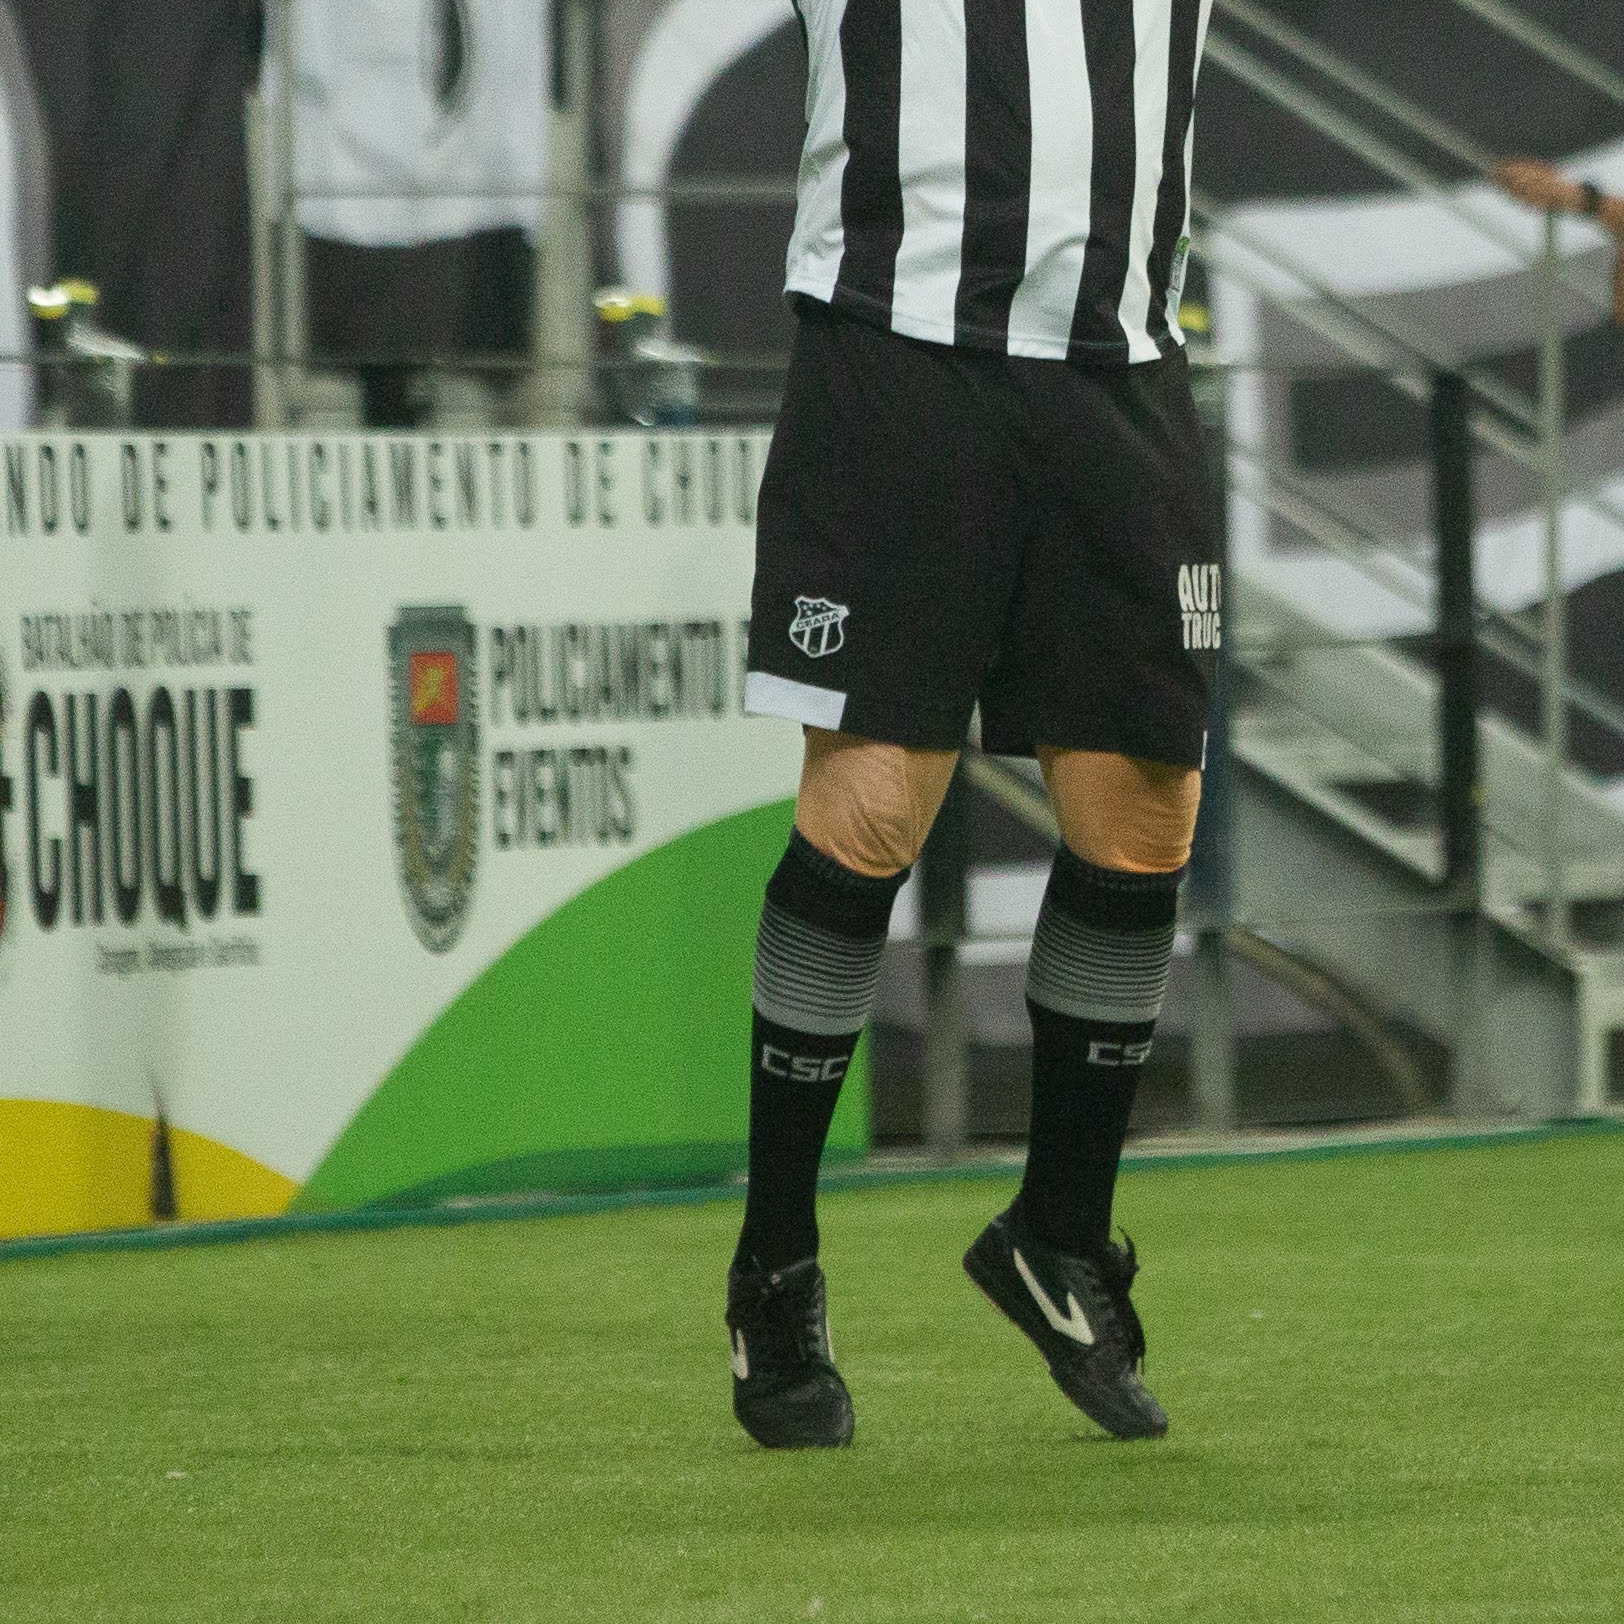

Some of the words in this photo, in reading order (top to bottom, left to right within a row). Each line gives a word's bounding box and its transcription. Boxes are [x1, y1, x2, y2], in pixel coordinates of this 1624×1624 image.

[122, 441, 172, 533] DE
[200, 439, 536, 533] POLICIAMENTO
[565, 438, 616, 529] DE
[1178, 563, 1222, 612] AUT
[27, 685, 261, 934] CHOQUE
[761, 1044, 849, 1082] CSC
